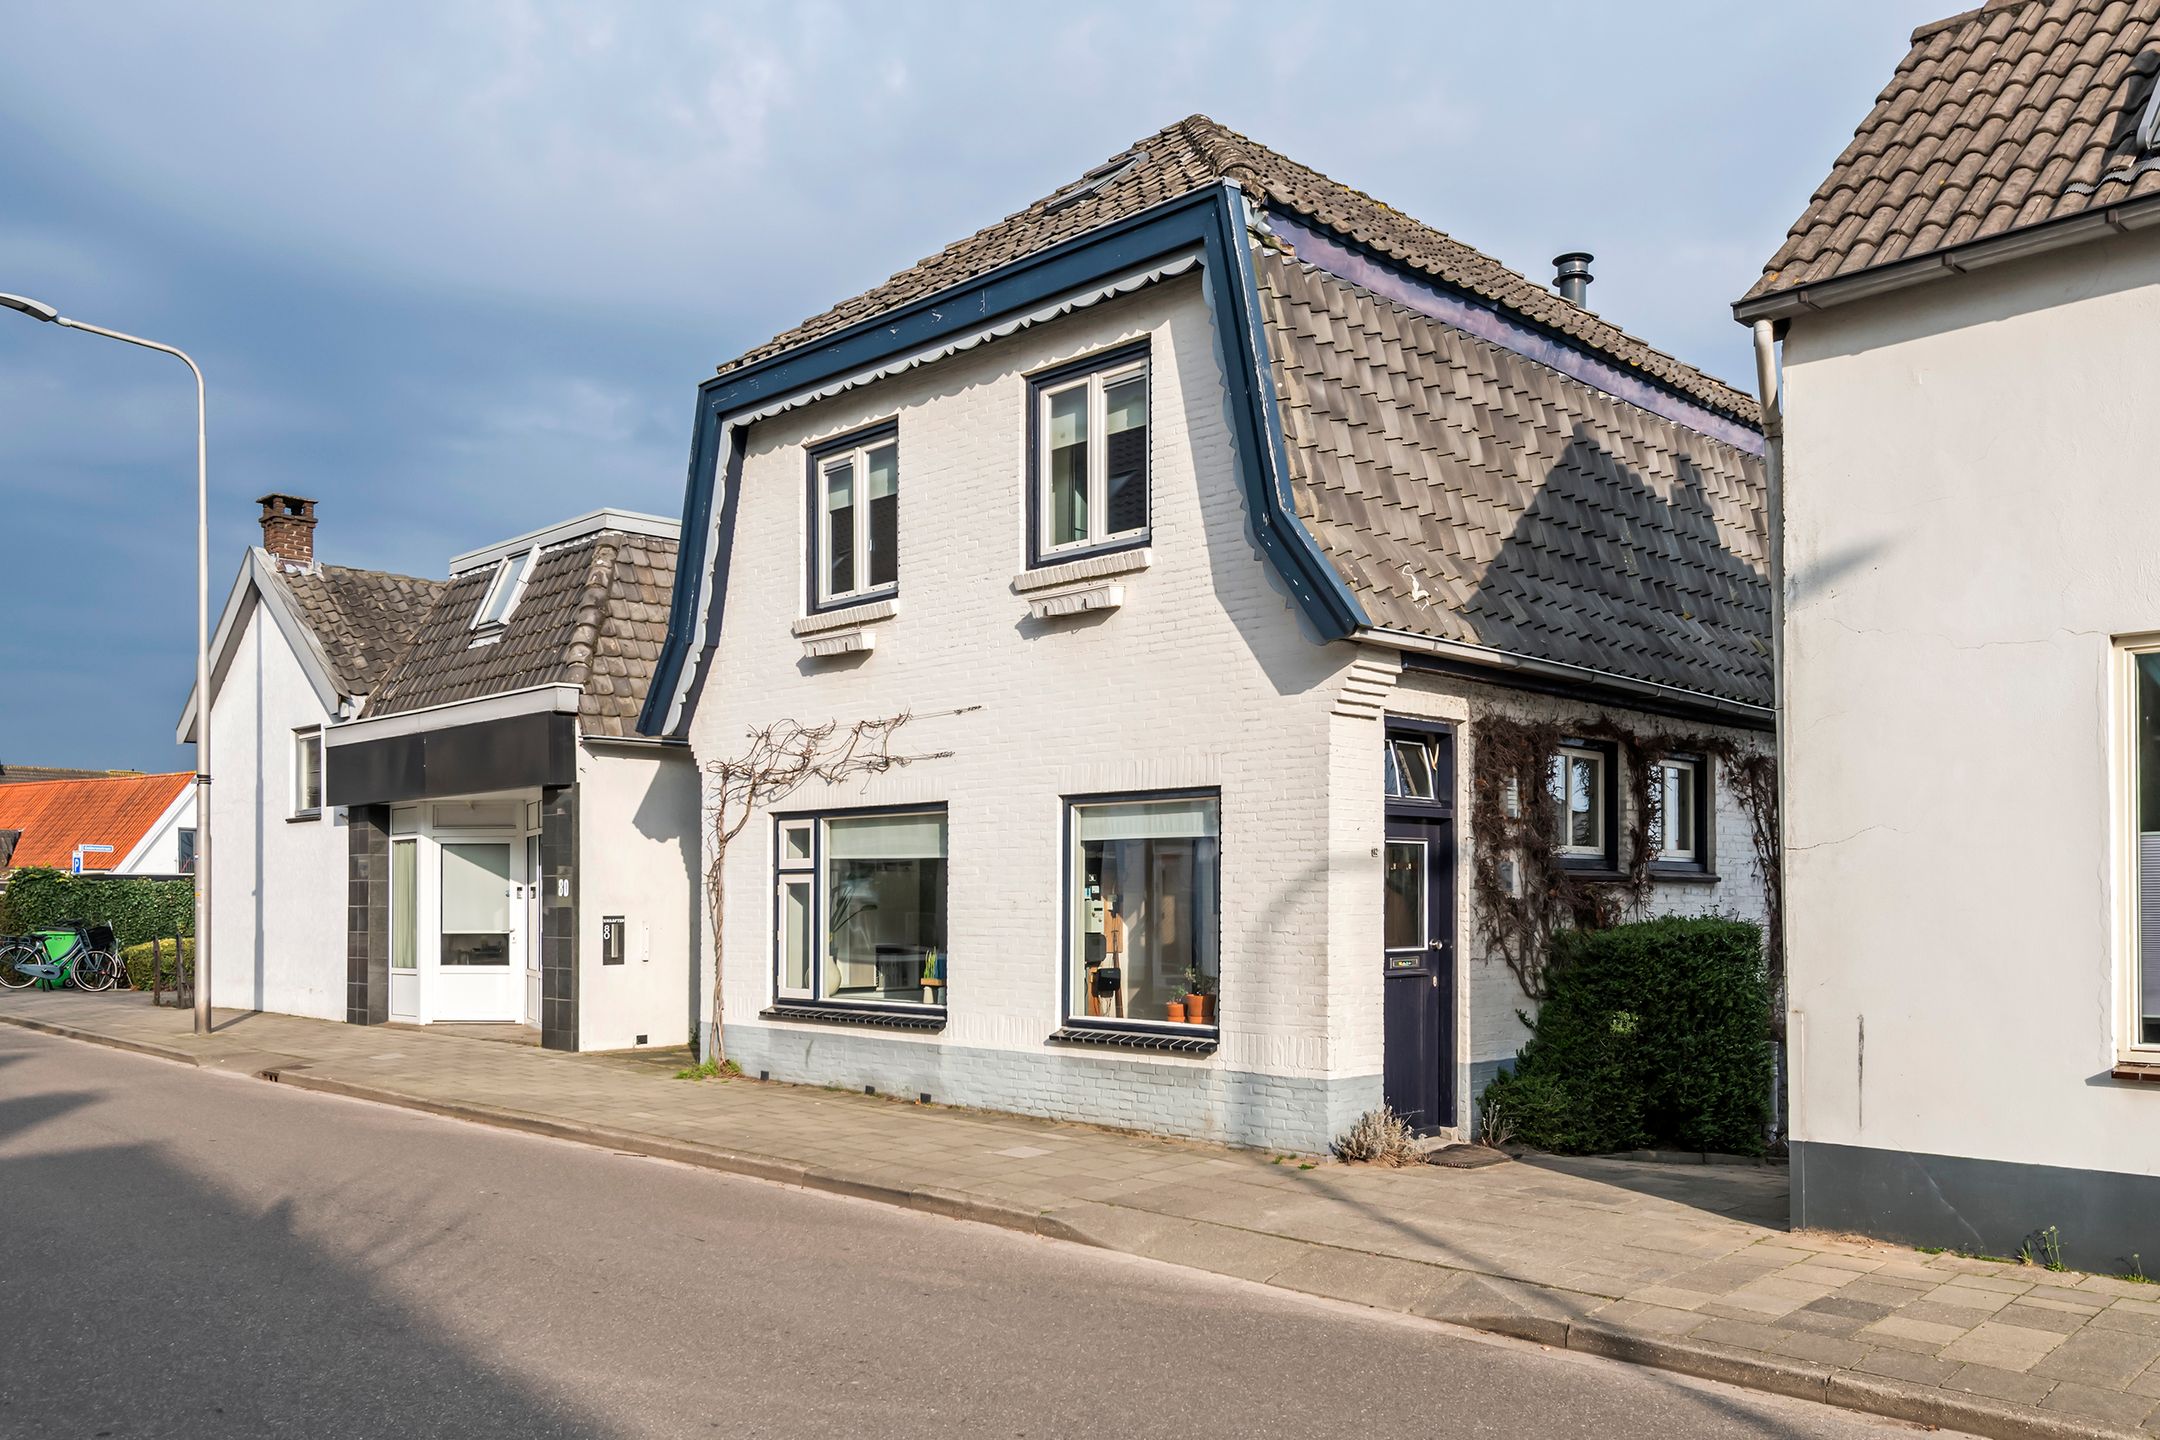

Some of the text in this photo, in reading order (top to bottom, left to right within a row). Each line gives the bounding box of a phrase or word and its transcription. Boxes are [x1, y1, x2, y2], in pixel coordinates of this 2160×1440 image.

[75, 858, 80, 872] P
[558, 879, 569, 897] 80
[603, 925, 610, 940] 80
